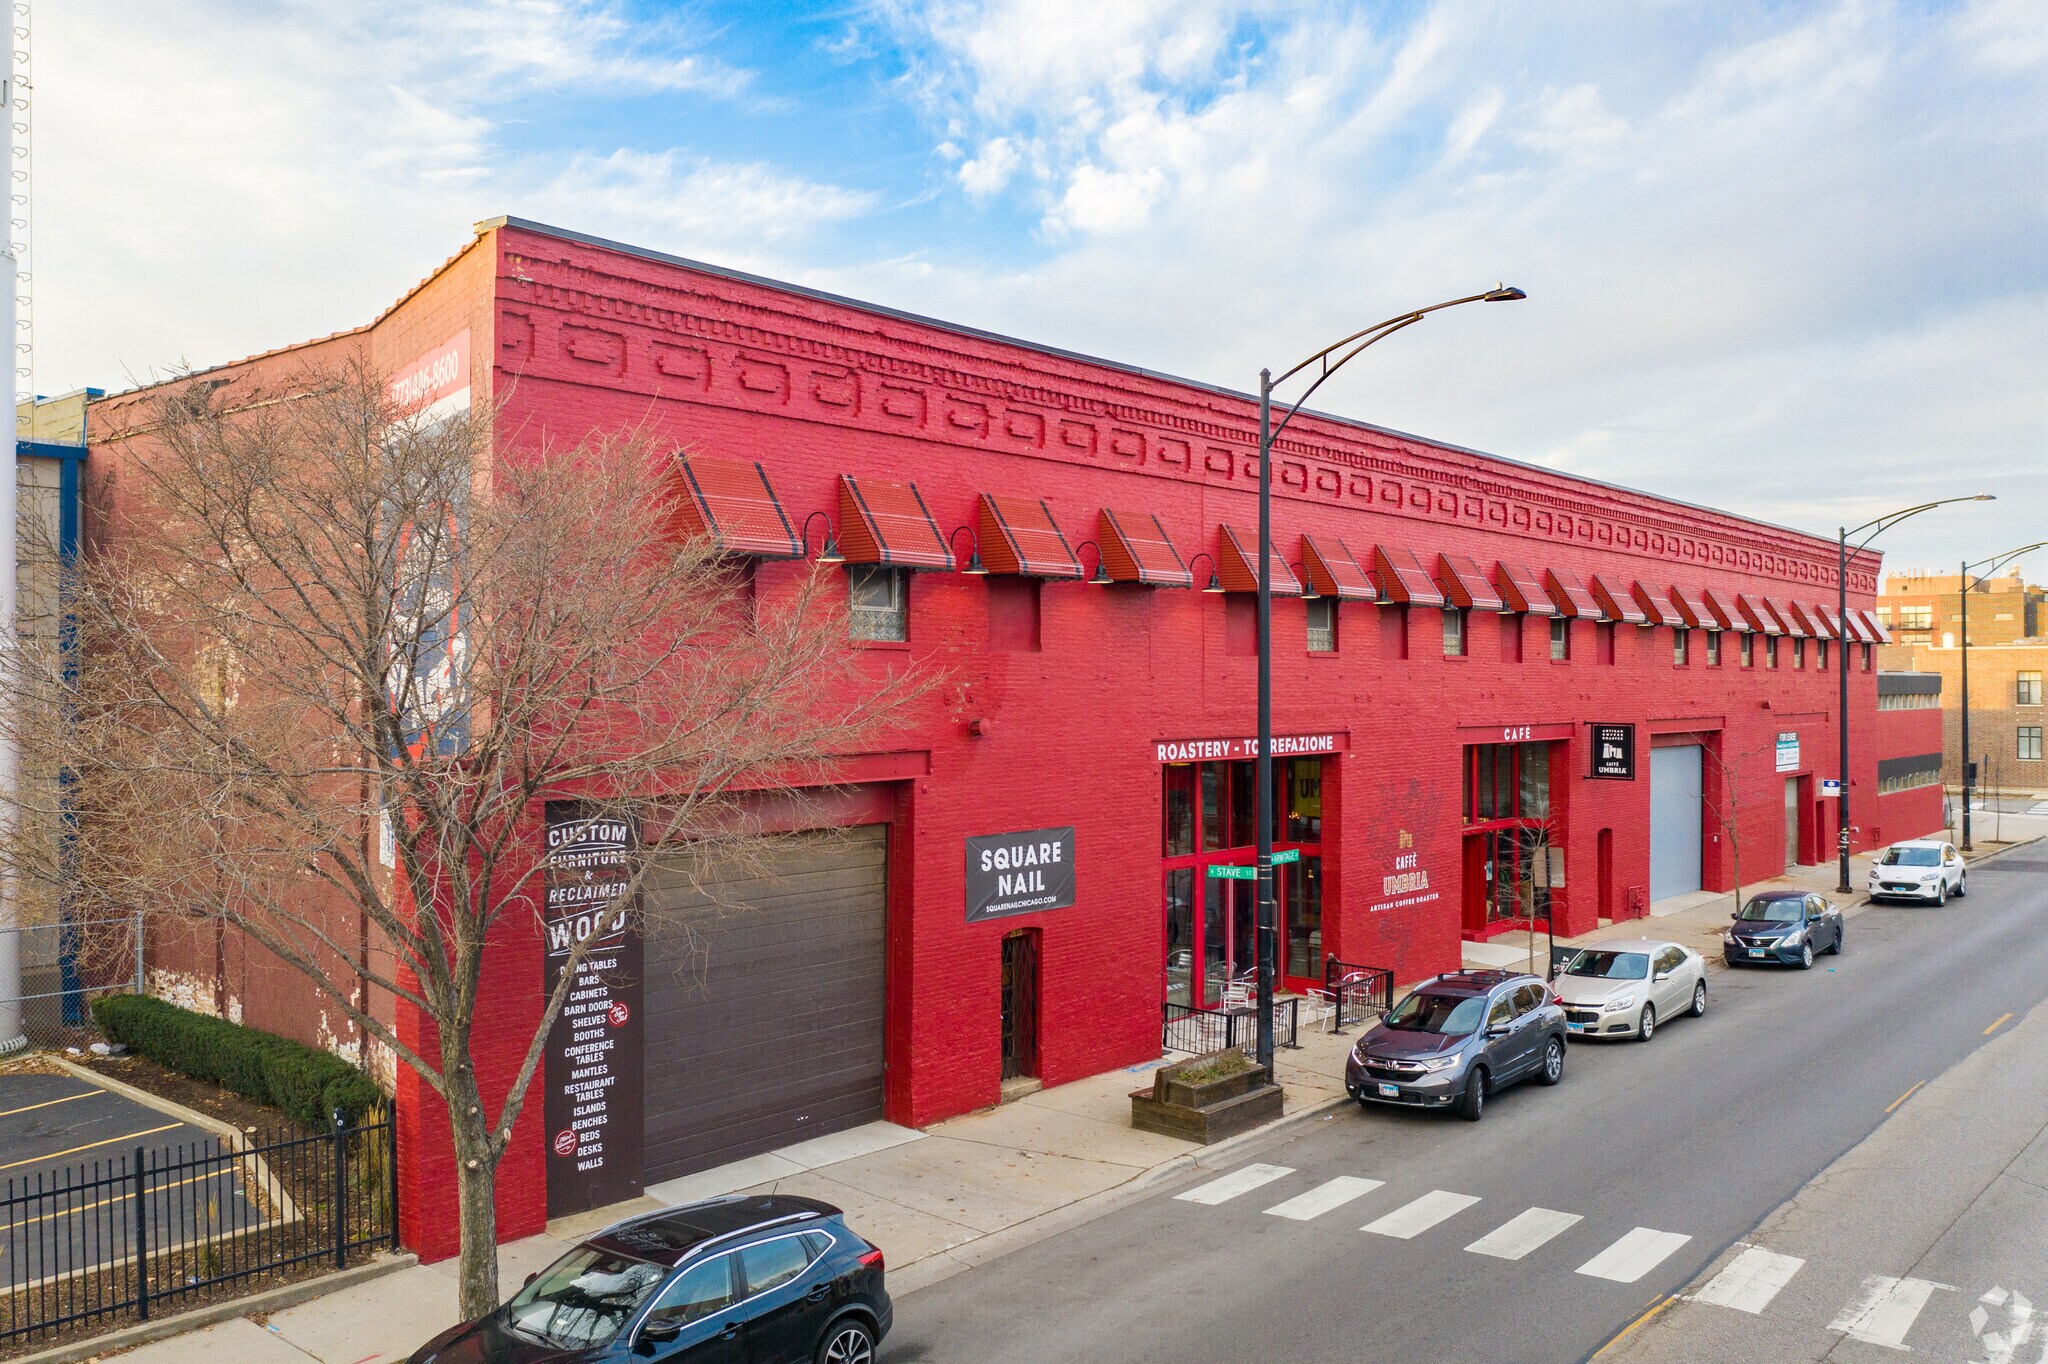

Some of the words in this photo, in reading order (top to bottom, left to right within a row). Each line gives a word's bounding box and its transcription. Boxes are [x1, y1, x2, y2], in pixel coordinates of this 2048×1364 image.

[1157, 740, 1231, 761] ROASTERY
[1243, 735, 1334, 755] TOREFAZIONE
[1598, 766, 1627, 774] UMBRIA
[548, 824, 628, 848] CUSTOM
[549, 849, 627, 870] FURNITURE
[981, 841, 1061, 872] SQUARE
[584, 870, 594, 881] &
[1216, 867, 1241, 877] STAVE
[998, 870, 1045, 897] NAIL
[1383, 870, 1429, 896] UMBRIA
[548, 882, 628, 903] RECLAIMED
[986, 895, 1057, 913] SQUARENAILCHICAGO.COM
[1369, 902, 1394, 912] ARTISAN
[1395, 897, 1415, 907] COFFEE
[1416, 892, 1439, 903] ROASTER
[589, 958, 618, 971] TABLES
[578, 974, 600, 987] BARS
[569, 987, 608, 1001] CABINETS
[564, 1004, 586, 1016] BARN
[588, 999, 614, 1012] DOORS
[572, 1014, 607, 1028] SHELVES
[573, 1028, 605, 1041] BOOTHS
[564, 1039, 615, 1057] CONFERENCE
[575, 1051, 604, 1065] TABLES
[571, 1064, 608, 1079] MANTLES
[564, 1076, 616, 1094] RESTAURANT
[575, 1088, 604, 1102] TABLES
[573, 1101, 607, 1116] ISLANDS
[571, 1114, 608, 1130] BENCHES
[580, 1129, 600, 1142] BEDS
[577, 1143, 603, 1157] DESKS
[577, 1157, 603, 1171] WALLS
